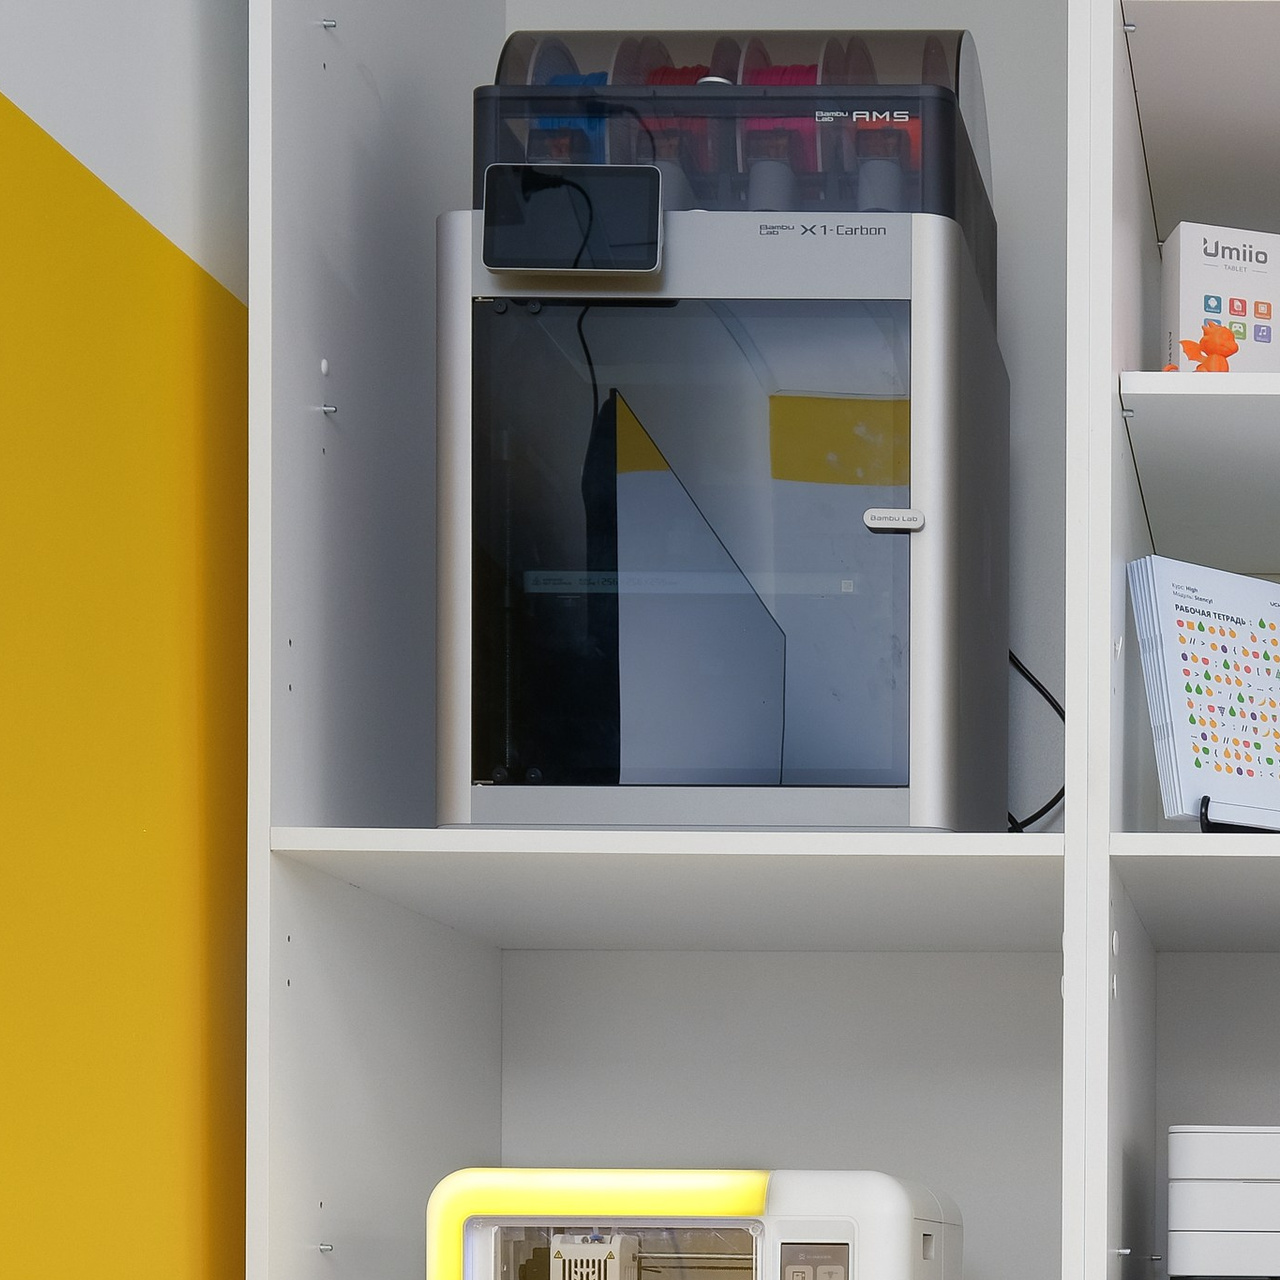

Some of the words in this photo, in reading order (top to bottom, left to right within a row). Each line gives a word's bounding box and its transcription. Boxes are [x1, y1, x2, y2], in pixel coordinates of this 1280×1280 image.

[852, 111, 910, 122] AMS
[1202, 237, 1268, 265] Umiio
[1224, 264, 1248, 273] TABLET
[870, 514, 900, 522] Bambu
[1174, 603, 1212, 619] РАБОЧАЯ
[1212, 612, 1246, 626] ТЕТРАДЬ
